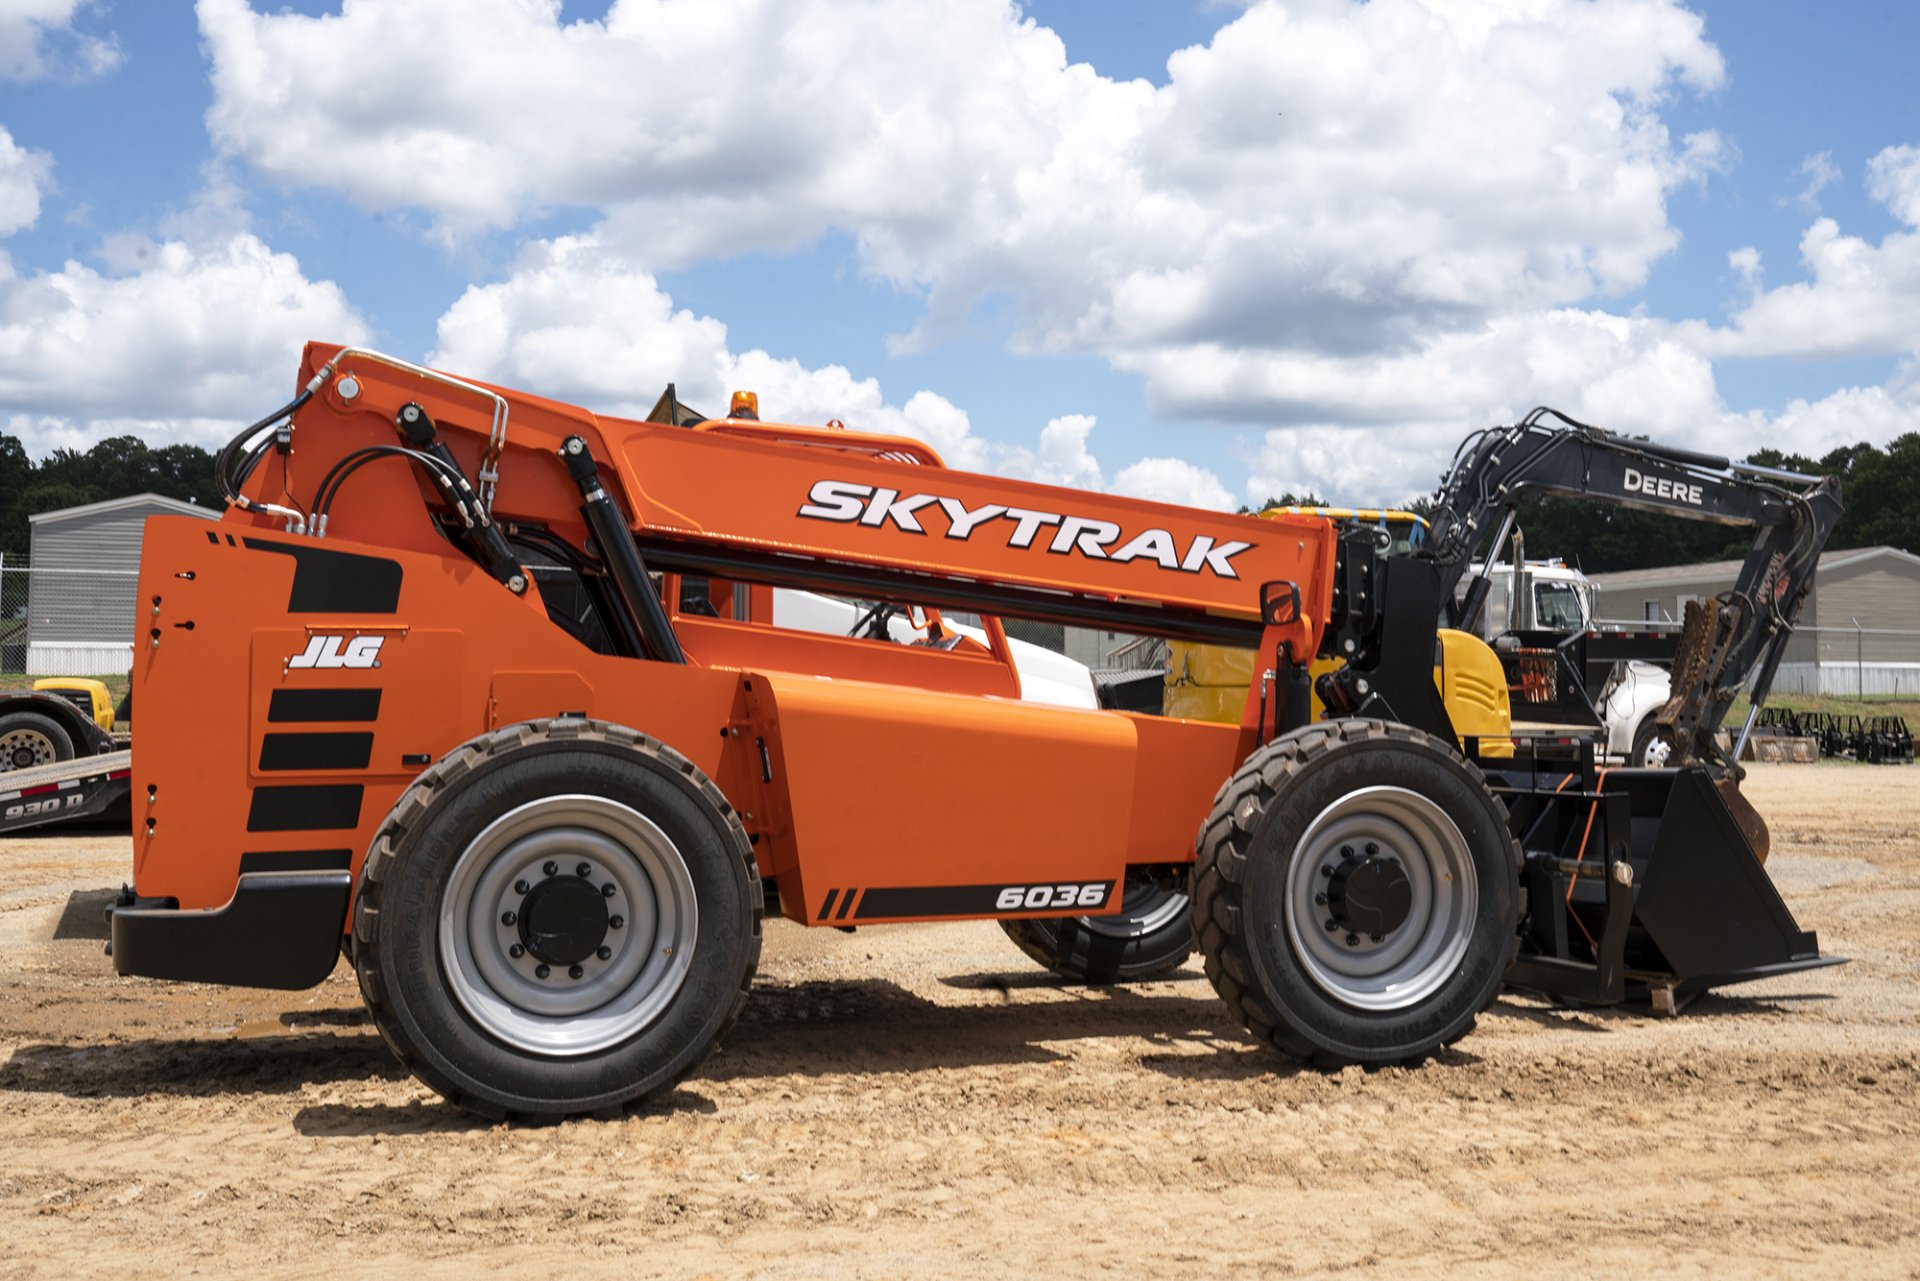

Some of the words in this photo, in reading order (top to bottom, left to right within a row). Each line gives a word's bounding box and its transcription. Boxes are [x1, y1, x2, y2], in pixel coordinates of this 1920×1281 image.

[1623, 467, 1704, 505] DEERE
[797, 480, 1257, 579] SKYTRAK
[287, 635, 386, 669] JLG
[5, 798, 60, 820] 930
[65, 793, 84, 809] D
[996, 883, 1106, 910] 6036
